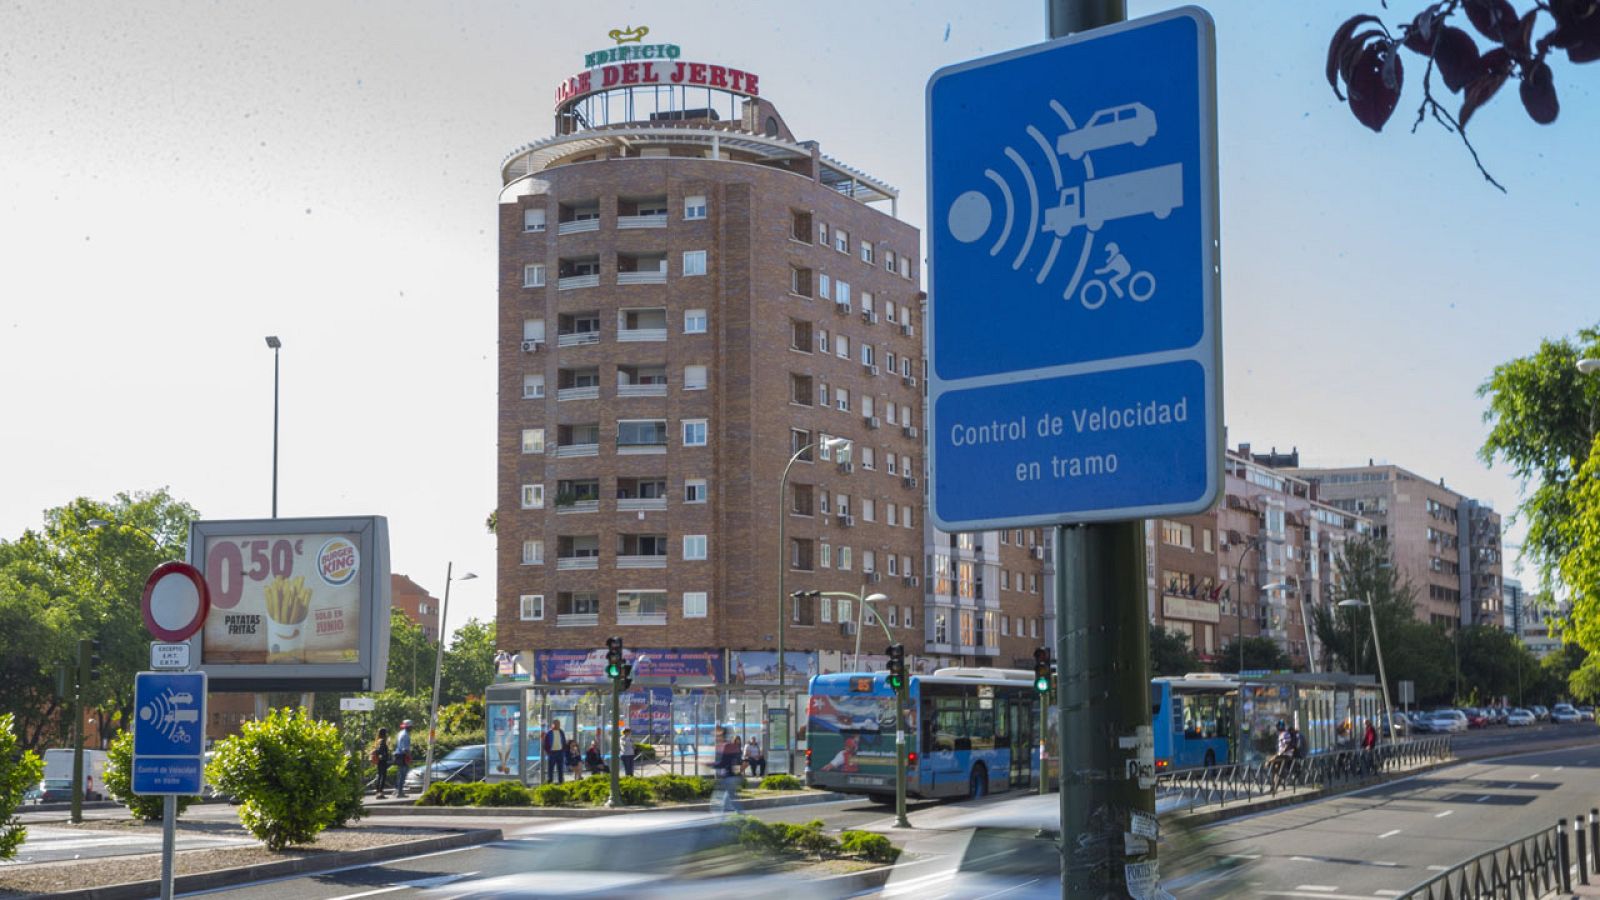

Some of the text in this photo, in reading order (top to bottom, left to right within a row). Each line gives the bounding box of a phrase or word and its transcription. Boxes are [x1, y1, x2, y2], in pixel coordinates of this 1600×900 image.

[585, 44, 681, 68] EDIFICIO
[602, 62, 659, 87] DEL
[670, 62, 759, 96] JERTE
[951, 397, 1187, 447] Control de Velocidad
[1016, 454, 1118, 481] en tramo
[321, 546, 354, 565] BURGER
[323, 555, 354, 577] KING
[225, 614, 261, 625] PATATAS
[228, 624, 256, 635] FRITAS
